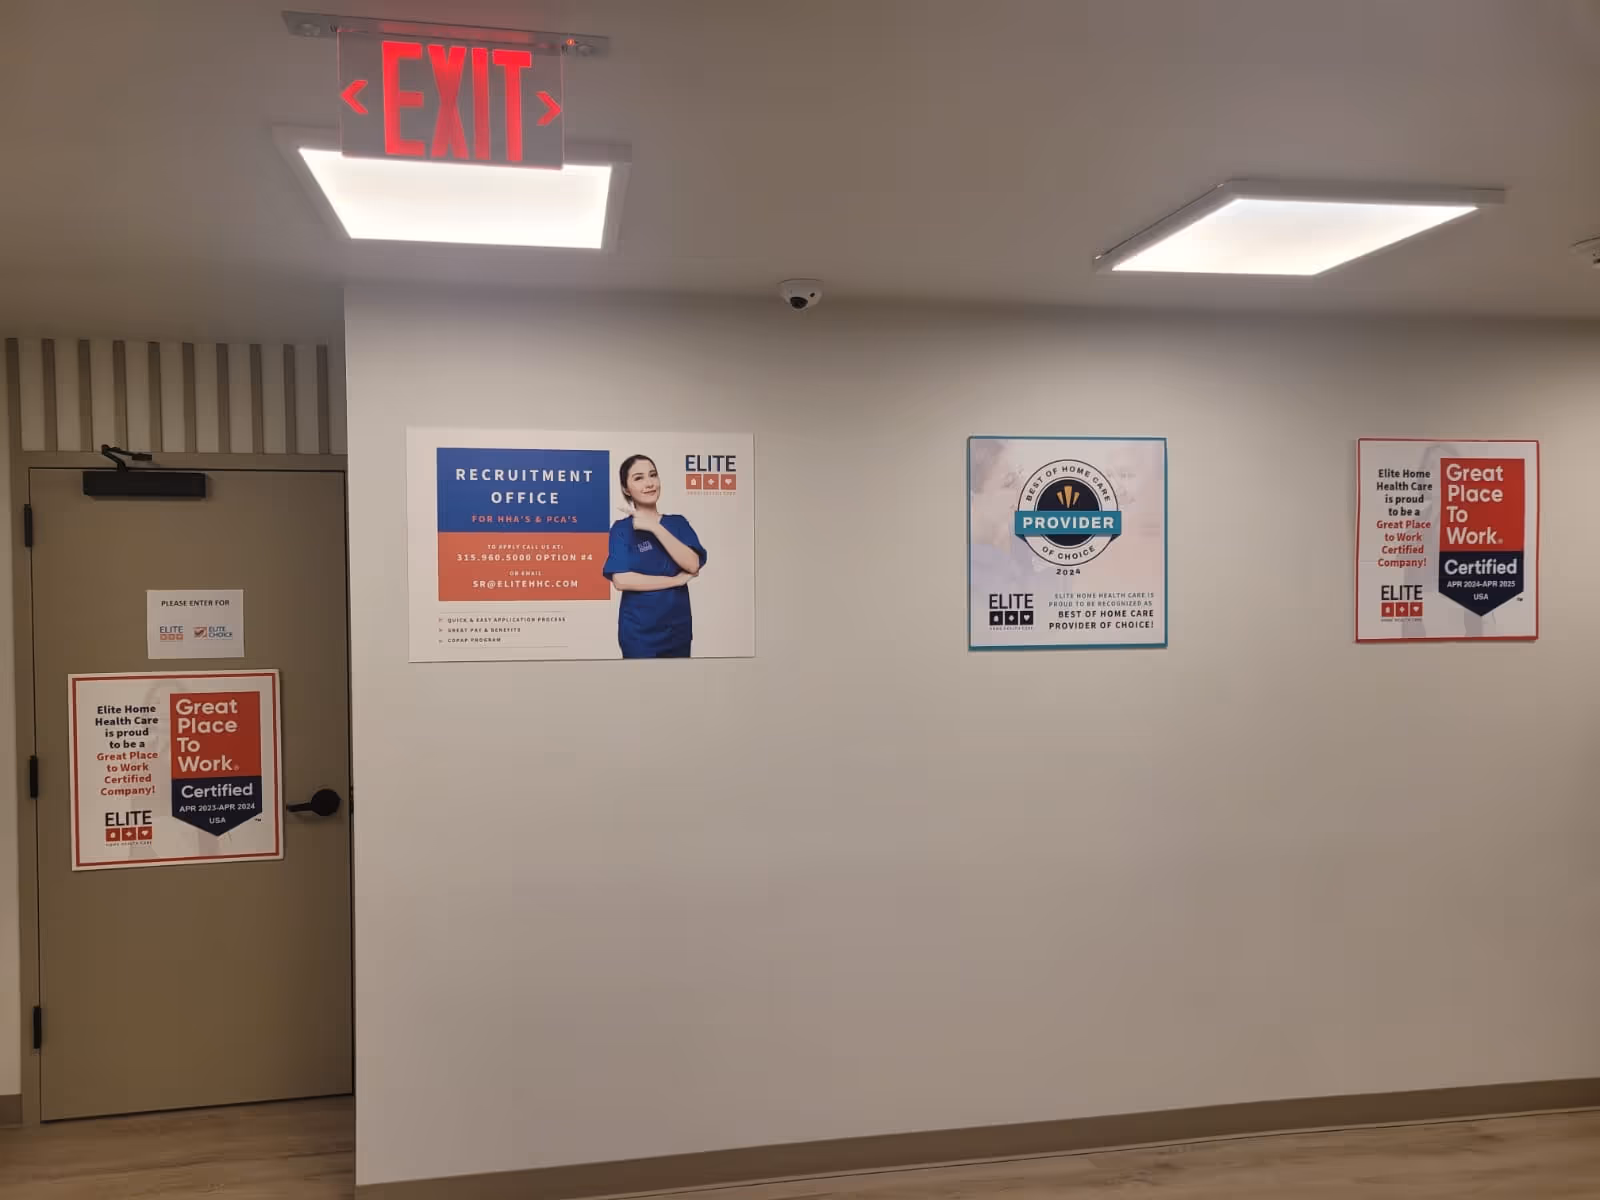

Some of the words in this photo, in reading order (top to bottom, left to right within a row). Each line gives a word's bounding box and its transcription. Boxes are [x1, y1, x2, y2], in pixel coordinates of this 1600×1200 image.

[382, 41, 532, 162] EXIT
[685, 454, 737, 472] ELITE
[455, 468, 593, 482] RECRUITMENT
[1378, 468, 1401, 478] Elite
[1402, 469, 1431, 478] Home
[1446, 463, 1504, 482] Great
[1026, 476, 1043, 502] BEST
[1045, 467, 1058, 478] OF
[1062, 466, 1091, 478] HOME
[1092, 476, 1111, 502] CARE
[1376, 481, 1409, 491] Health
[1410, 481, 1433, 491] Care
[491, 491, 559, 504] OFFICE
[1384, 493, 1394, 503] is
[1395, 494, 1425, 505] proud
[1447, 484, 1504, 503] Place
[1388, 507, 1399, 516] to
[1400, 506, 1413, 516] be
[1414, 508, 1421, 516] a
[1446, 505, 1469, 523] To
[472, 515, 493, 523] FOR
[498, 515, 531, 523] HHA'S
[547, 515, 578, 523] PCA'S
[1023, 516, 1115, 529] PROVIDER
[1376, 520, 1404, 529] Great
[1405, 520, 1432, 529] Place
[1384, 533, 1395, 541] to
[1396, 532, 1423, 541] Work
[1042, 546, 1055, 556] OF
[1057, 545, 1096, 561] CHOICE
[1381, 545, 1425, 554] Certified
[456, 553, 532, 561] 315.960.5000
[535, 553, 577, 561] OPTION
[580, 553, 593, 561] #4
[1377, 557, 1427, 568] Company!
[1056, 568, 1081, 576] 2024
[1444, 558, 1518, 575] Certified
[472, 580, 578, 589] SR@ELITEHHC.COM
[1381, 584, 1423, 600] ELITE
[989, 593, 1034, 609] ELITE
[1058, 610, 1082, 618] BEST
[1084, 610, 1097, 618] OF
[1100, 610, 1127, 618] HOME
[1130, 609, 1155, 617] CARE
[160, 625, 183, 633] ELITE
[1048, 622, 1097, 630] PROVIDER
[1099, 621, 1112, 629] OF
[1115, 620, 1155, 629] CHOICE!
[97, 706, 122, 715] Elite
[124, 705, 157, 713] Home
[176, 698, 238, 715] Great
[95, 717, 132, 726] Health
[133, 716, 159, 725] Care
[178, 717, 238, 734] Place
[104, 728, 114, 738] is
[116, 728, 150, 738] proud
[109, 741, 120, 749] to
[123, 740, 137, 748] be
[177, 737, 201, 753] To
[96, 752, 127, 761] Great
[129, 751, 159, 759] Place
[106, 764, 118, 772] to
[120, 763, 149, 771] Work
[104, 774, 152, 784] Certified
[100, 785, 155, 796] Company!
[181, 783, 253, 798] Certified
[105, 810, 152, 826] ELITE
